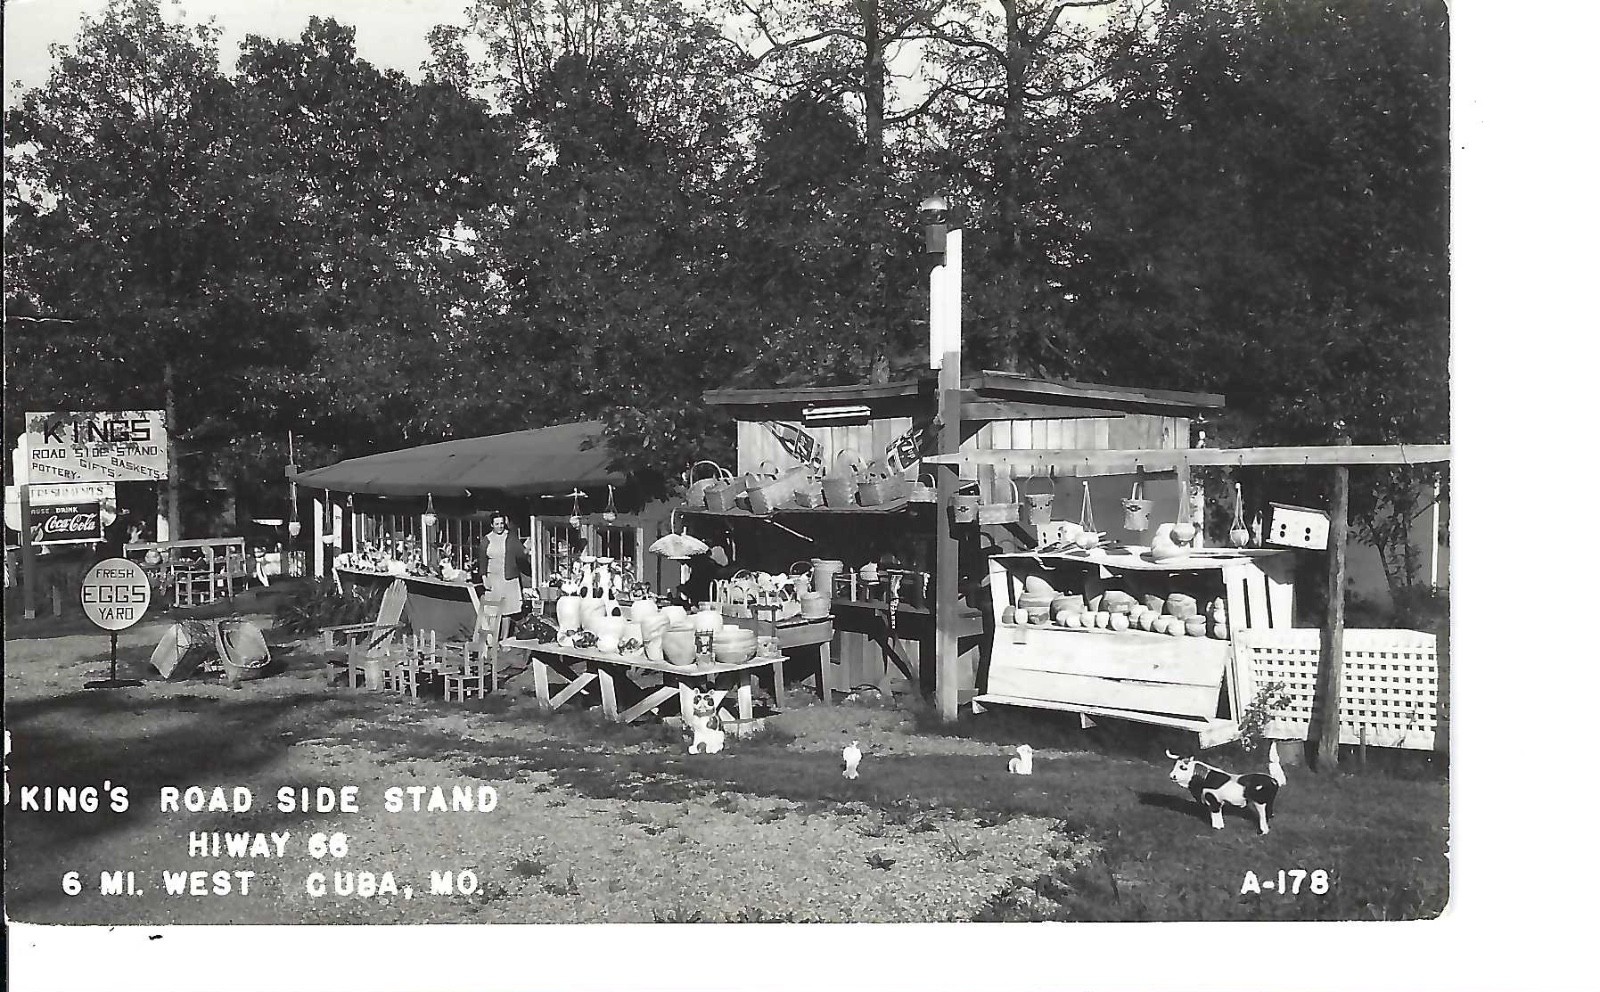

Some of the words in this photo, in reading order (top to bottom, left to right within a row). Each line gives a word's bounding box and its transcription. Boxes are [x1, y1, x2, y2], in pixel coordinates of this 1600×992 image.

[43, 419, 151, 444] KINGS
[32, 448, 66, 459] ROAD
[74, 447, 109, 458] SIDE
[55, 506, 79, 514] DRINK
[44, 513, 97, 533] Coca-Cola
[96, 569, 134, 578] FRESH
[84, 585, 145, 603] EGGS
[98, 607, 133, 620] YARD
